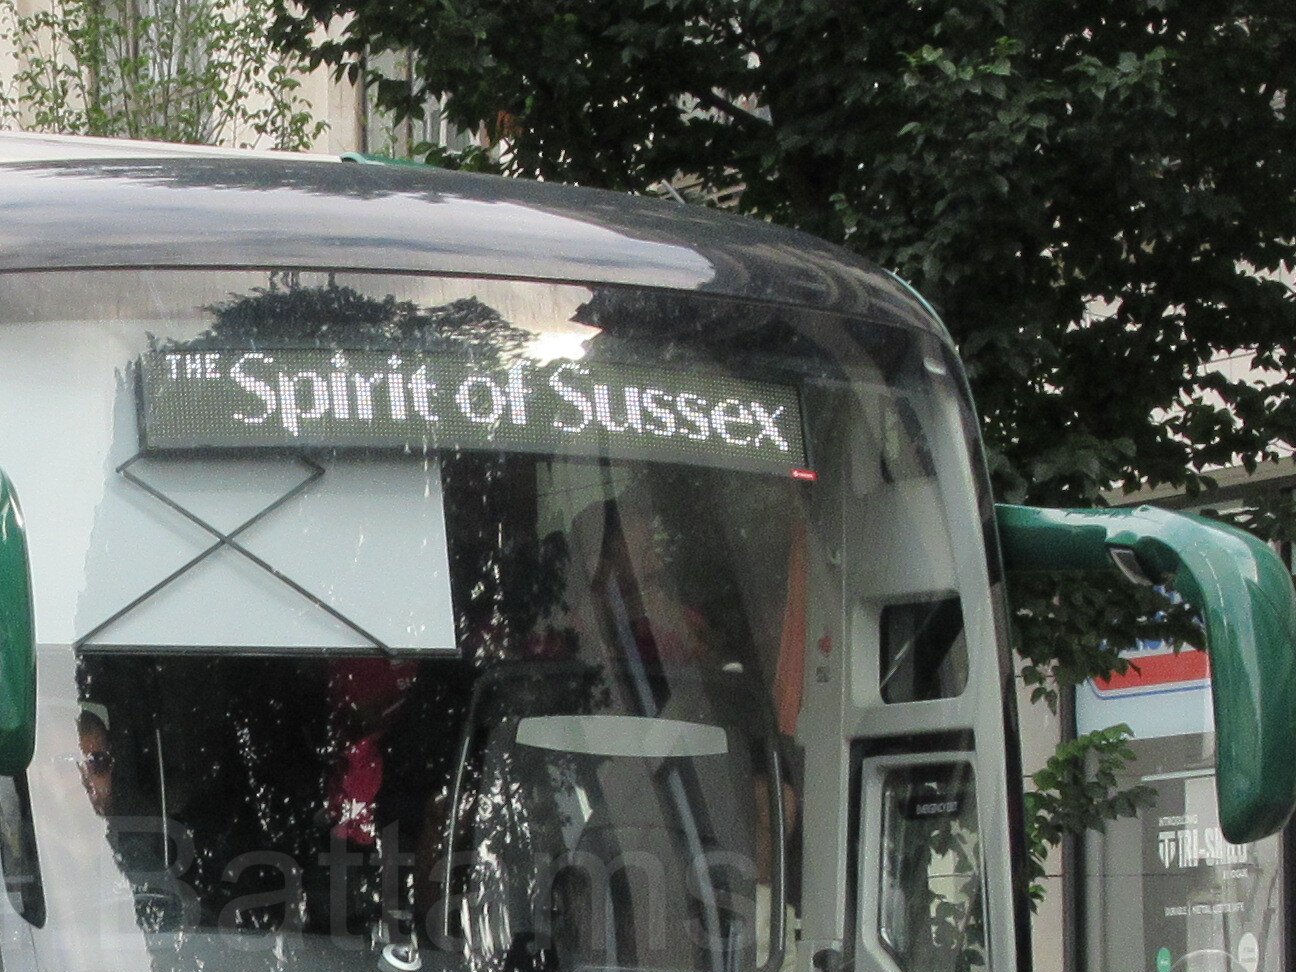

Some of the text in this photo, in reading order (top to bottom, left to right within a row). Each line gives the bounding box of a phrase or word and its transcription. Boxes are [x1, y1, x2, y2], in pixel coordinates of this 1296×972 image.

[165, 353, 791, 452] THE Spirit of Sussex
